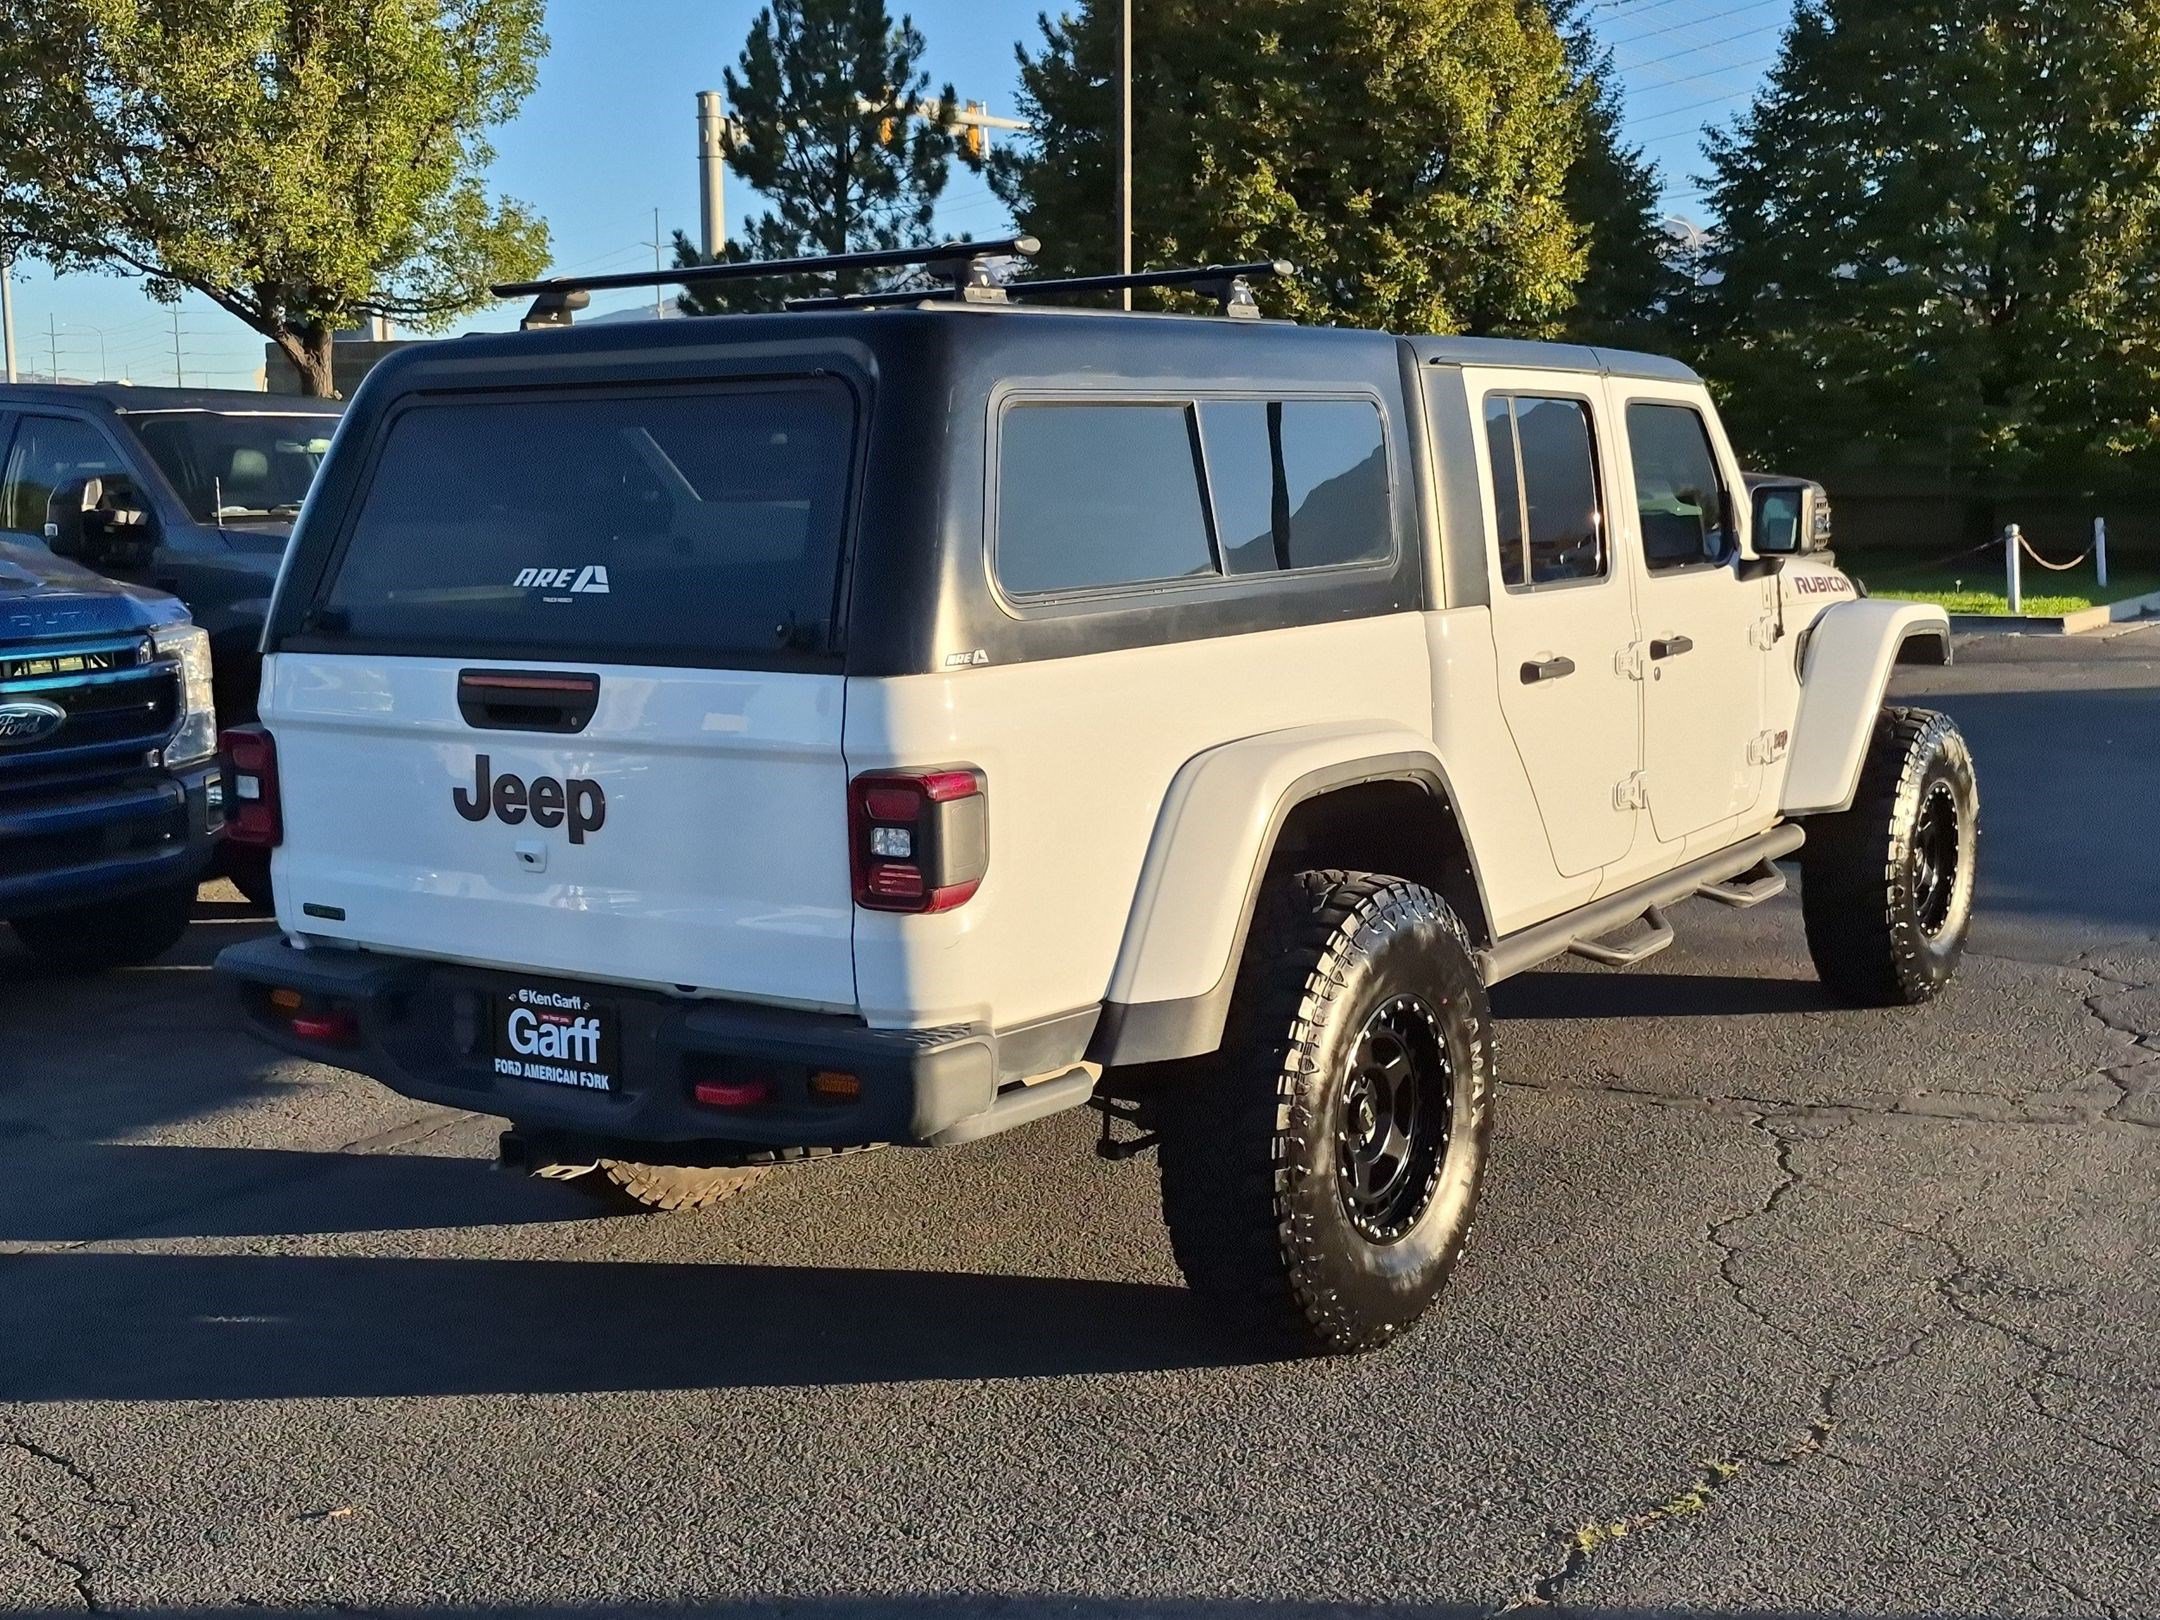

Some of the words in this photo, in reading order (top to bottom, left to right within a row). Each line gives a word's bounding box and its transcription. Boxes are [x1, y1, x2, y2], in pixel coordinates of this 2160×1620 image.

[1793, 576, 1852, 595] RUBICON
[453, 754, 606, 845] Jeep
[528, 989, 552, 1006] Ken
[552, 993, 581, 1010] Garff
[508, 1007, 601, 1064] Garff
[494, 1058, 522, 1076] FORD
[524, 1063, 578, 1085] AMERICAN
[579, 1071, 610, 1091] FORK
